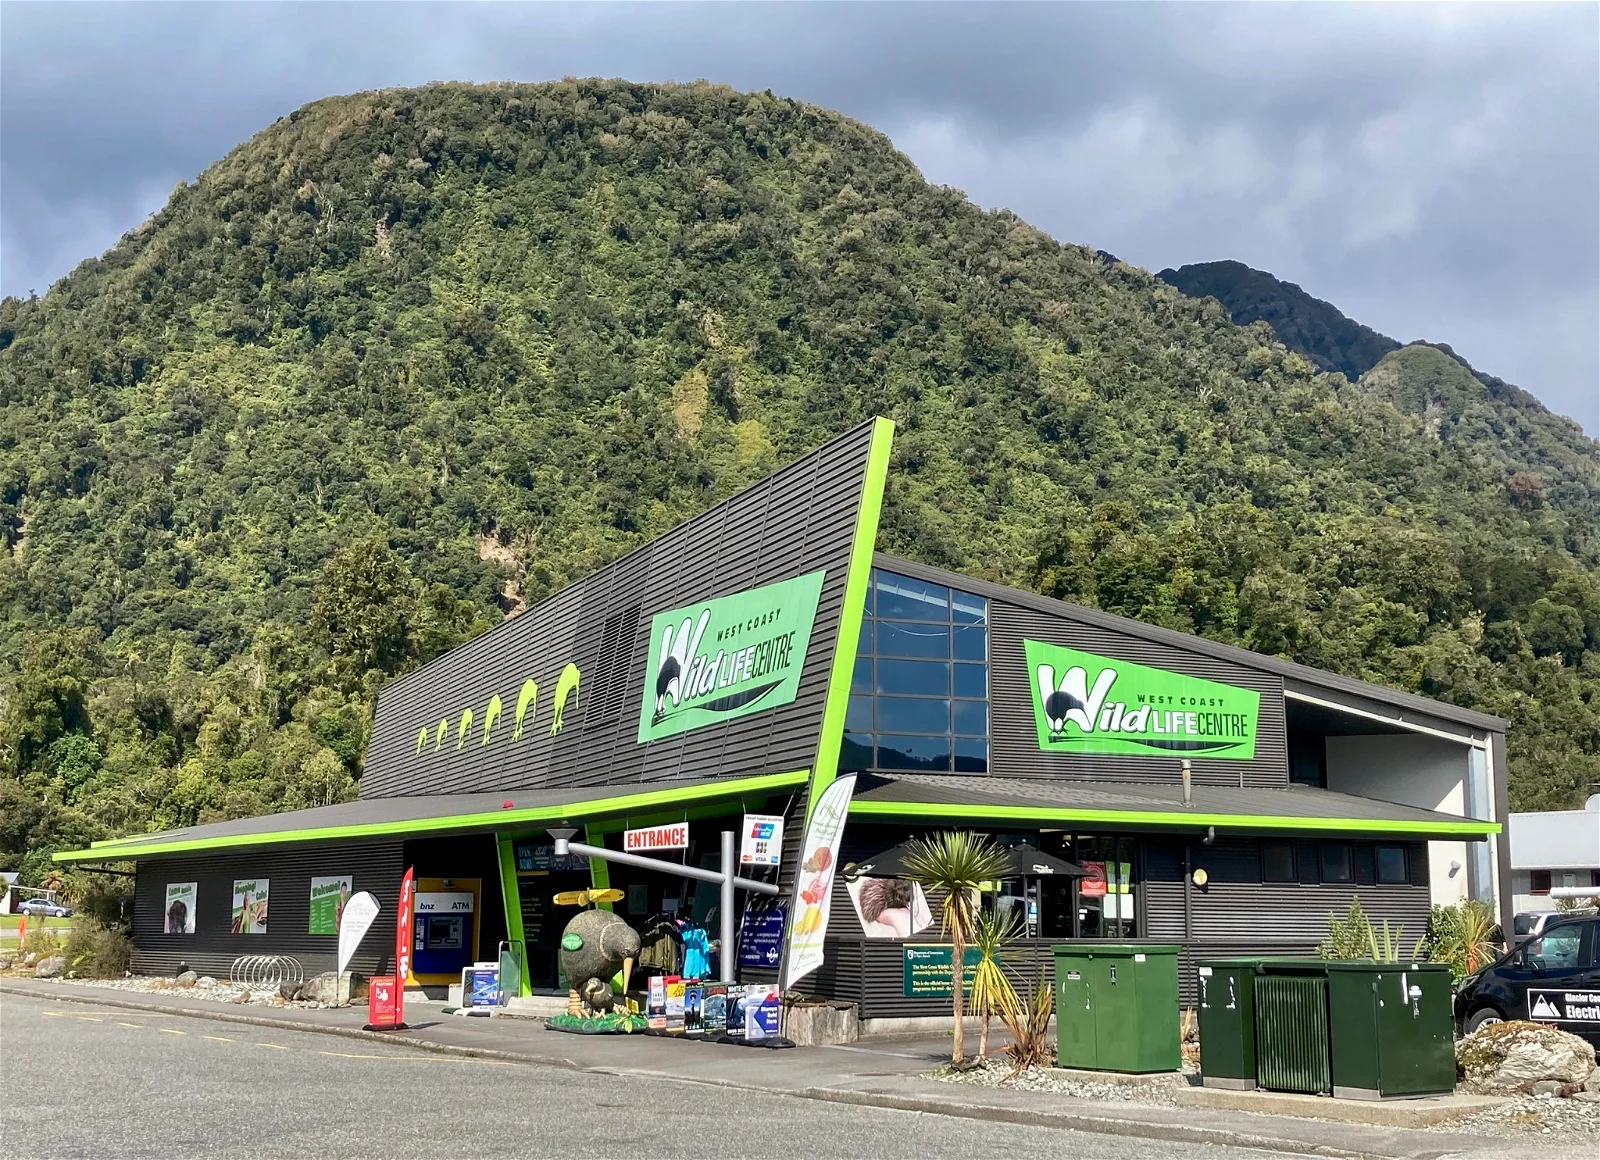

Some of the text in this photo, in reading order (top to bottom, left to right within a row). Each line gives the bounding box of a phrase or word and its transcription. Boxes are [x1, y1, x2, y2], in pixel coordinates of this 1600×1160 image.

[717, 608, 781, 642] WEST COAST
[1137, 694, 1224, 707] WEST COAST
[627, 827, 685, 848] ENTRANCE
[420, 902, 470, 910] bnz ATM
[1565, 993, 1588, 1002] Glacier
